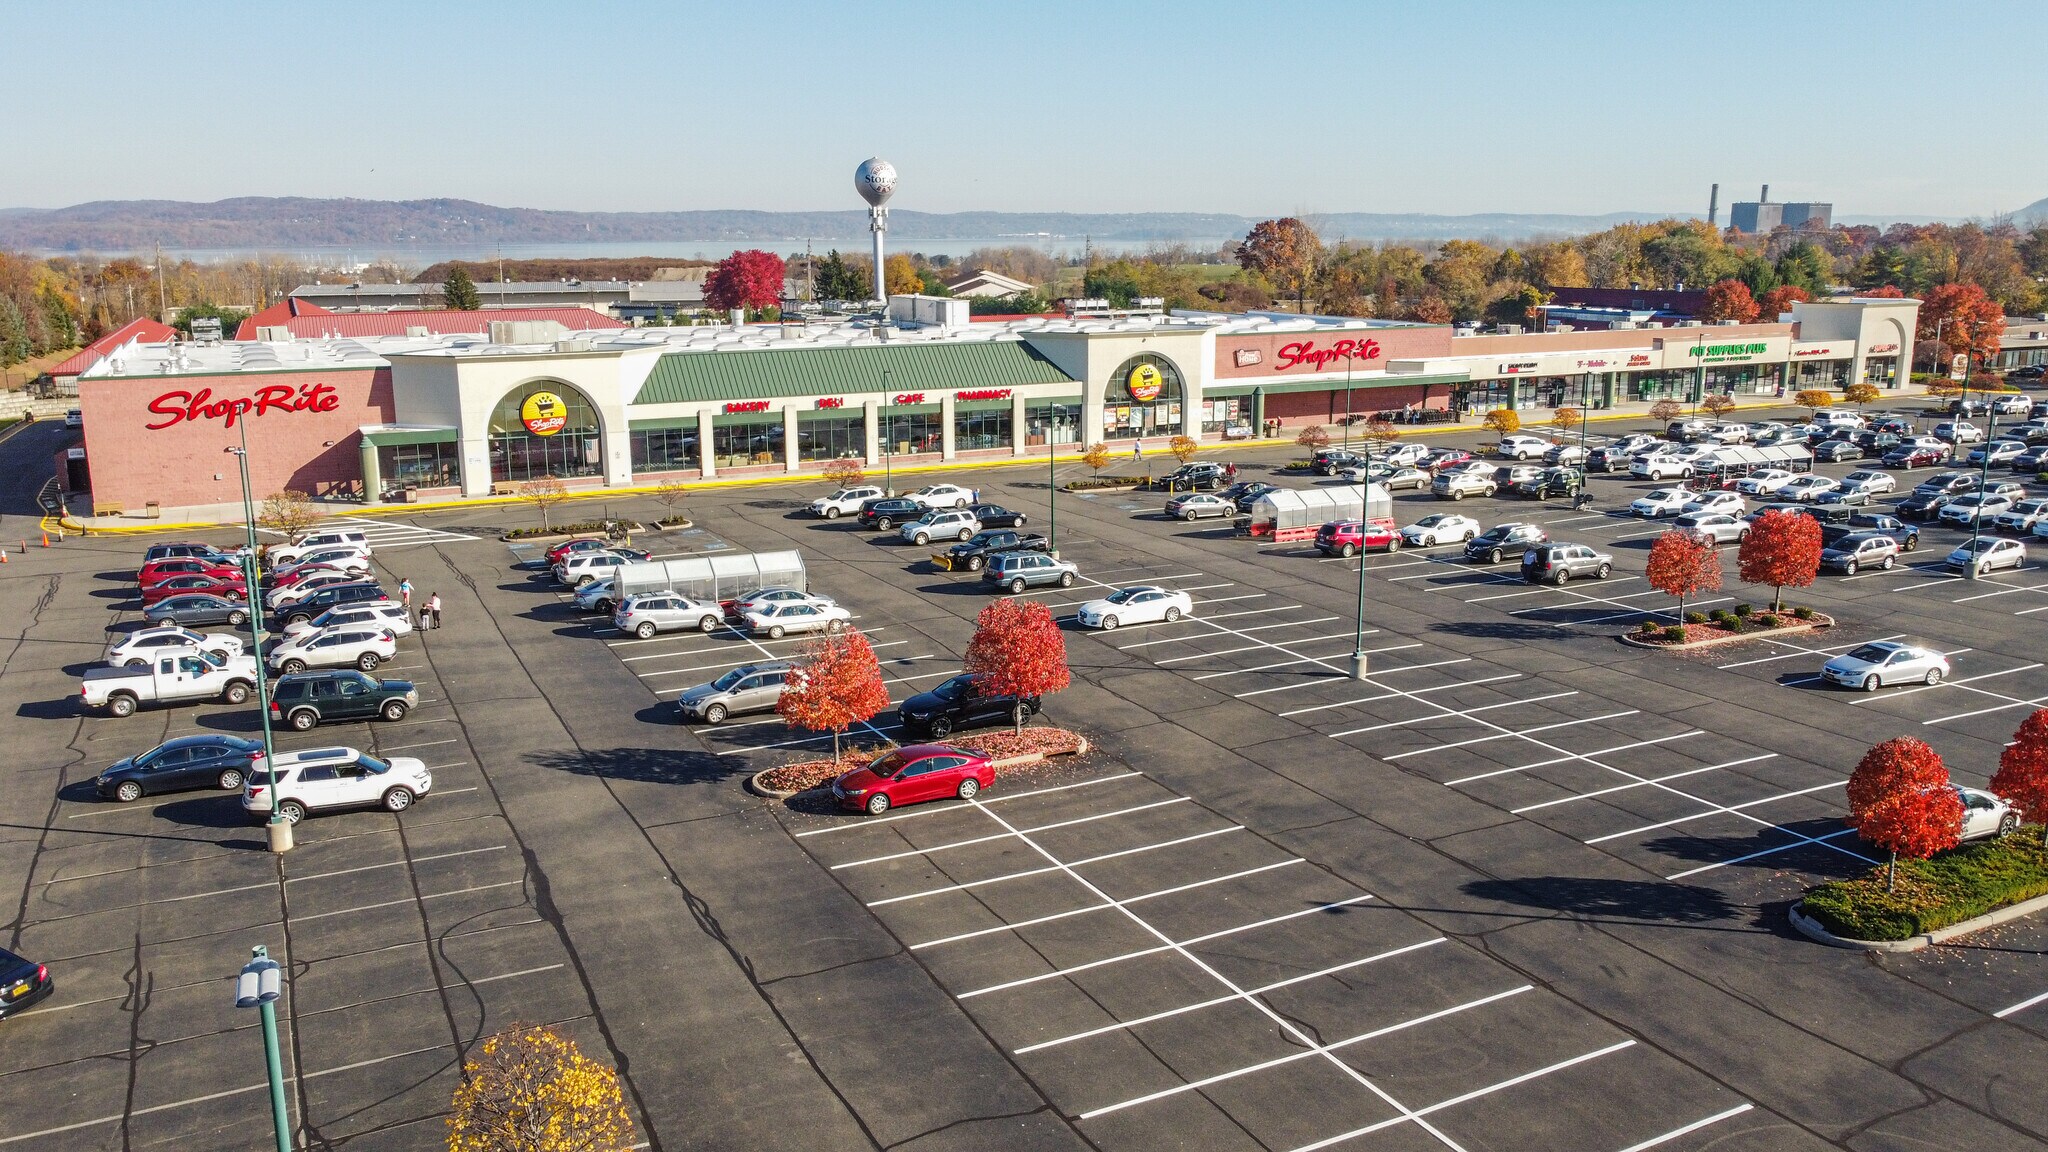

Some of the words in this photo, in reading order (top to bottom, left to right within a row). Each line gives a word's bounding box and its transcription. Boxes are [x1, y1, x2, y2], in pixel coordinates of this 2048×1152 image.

[1274, 339, 1380, 370] ShopRite
[1690, 346, 1707, 356] PET
[1707, 344, 1746, 356] SUPPLIES
[1746, 343, 1767, 354] PLUS
[897, 393, 923, 404] CAFE
[957, 389, 1012, 400] PHARMACY
[147, 384, 339, 429] ShopRite
[726, 401, 771, 413] BAKERY
[819, 397, 844, 408] DELI
[530, 417, 565, 431] ShopRite
